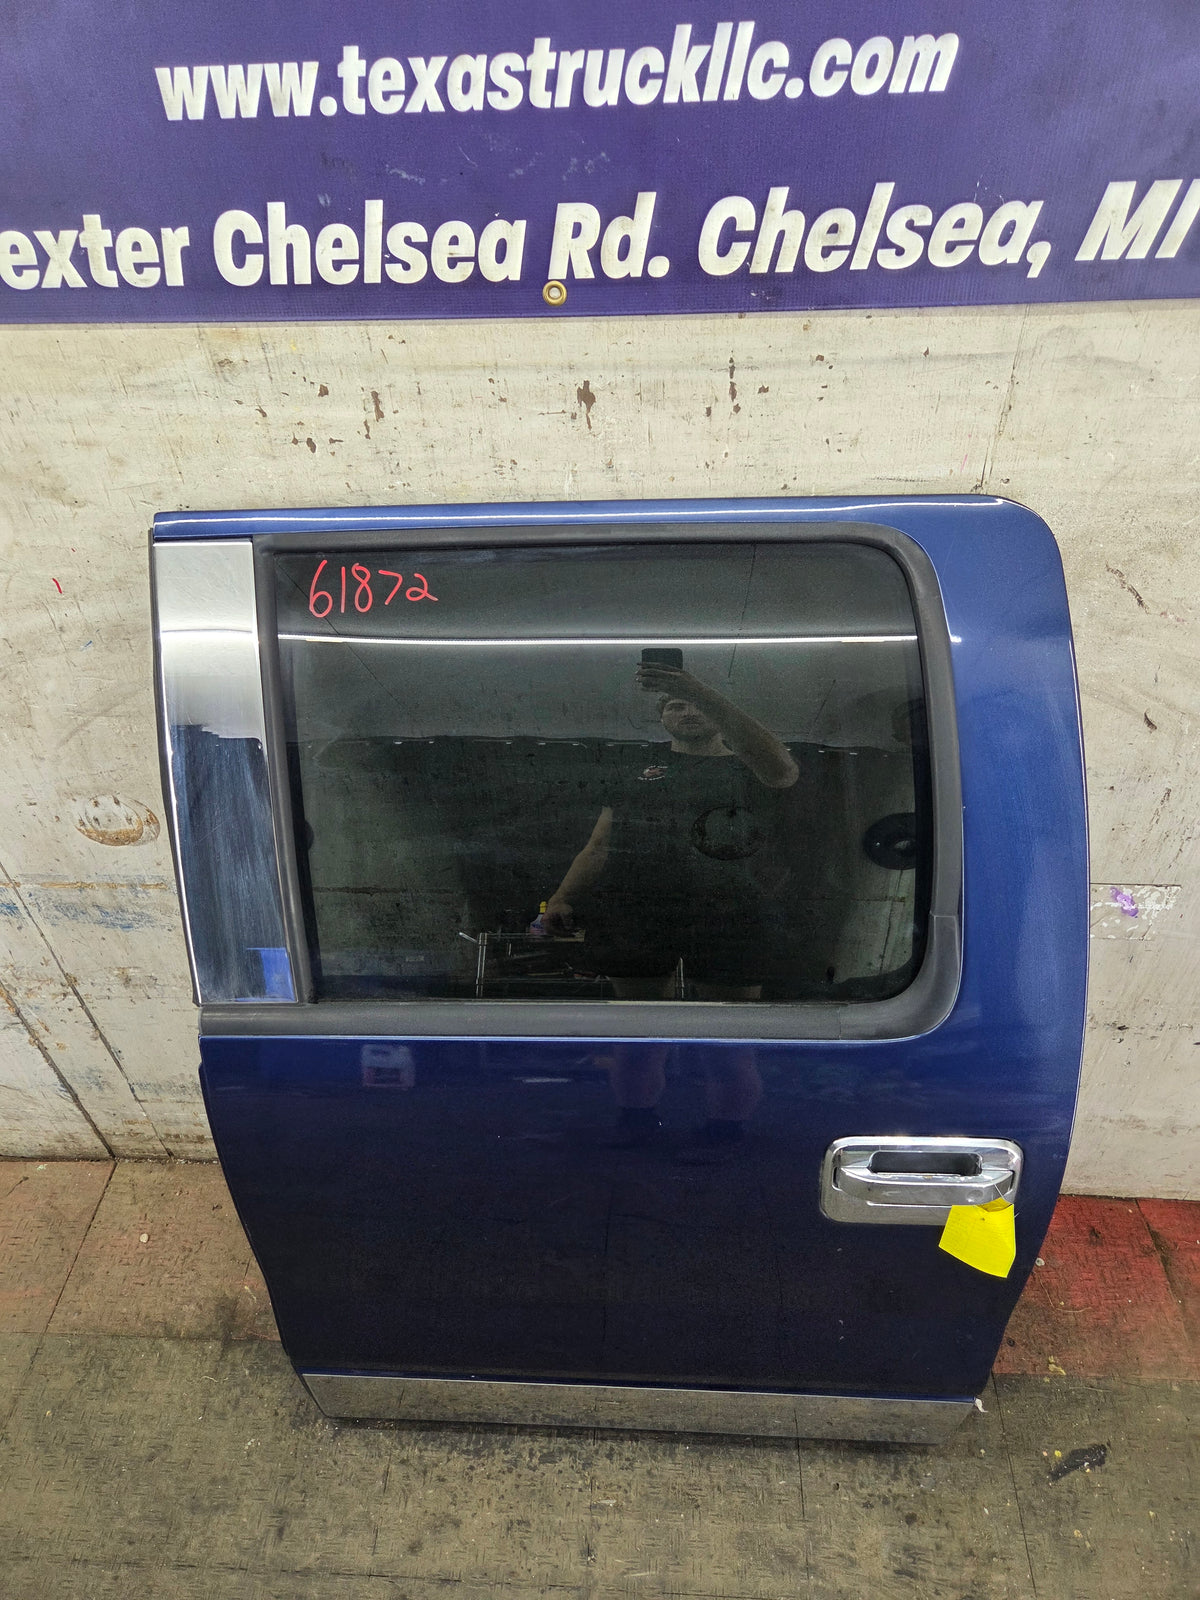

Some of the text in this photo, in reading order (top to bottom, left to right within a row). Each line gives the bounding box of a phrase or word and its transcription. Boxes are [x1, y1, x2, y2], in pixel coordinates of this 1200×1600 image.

[155, 21, 959, 121] www.texastruckllc.com
[0, 178, 1200, 290] exter Chelsea Rd. Chelsea, MI
[309, 559, 439, 618] 61872
